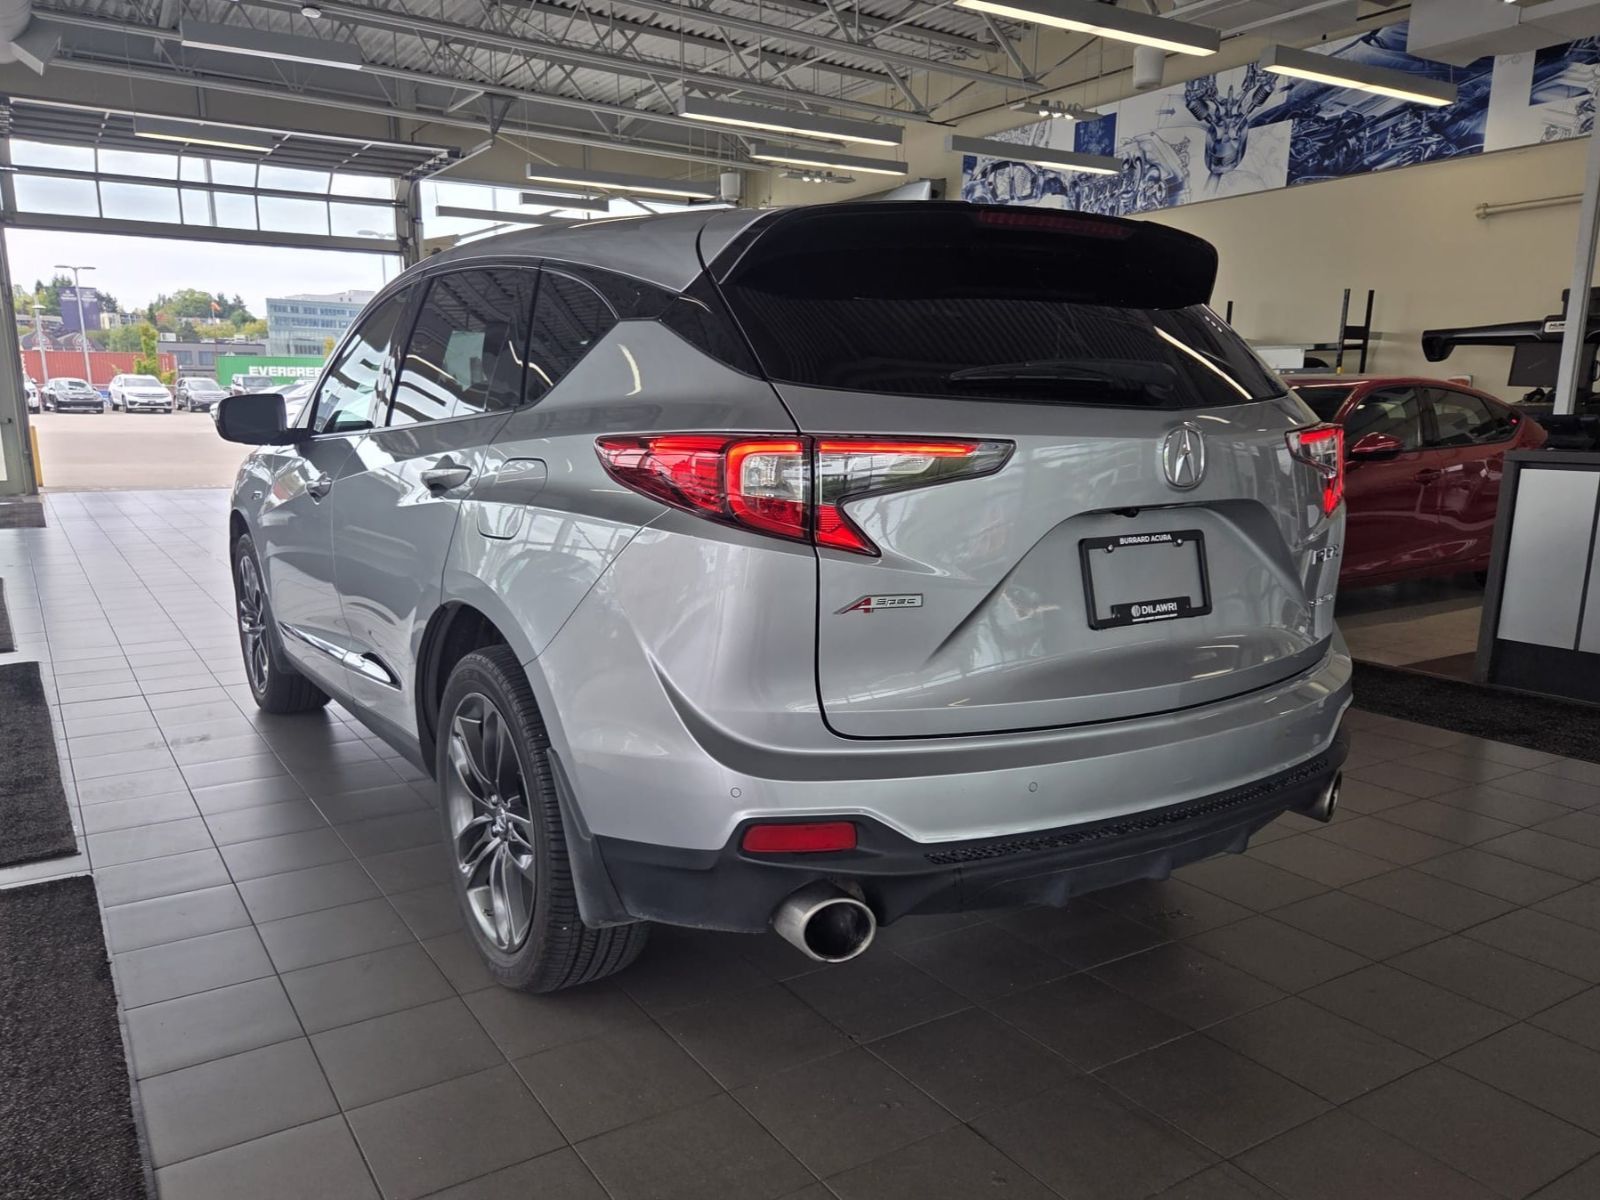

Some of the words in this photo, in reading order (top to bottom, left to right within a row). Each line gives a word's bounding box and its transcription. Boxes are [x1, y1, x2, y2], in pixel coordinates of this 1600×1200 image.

[1119, 535, 1150, 545] BURRARD
[1151, 533, 1172, 542] ACURA
[1141, 602, 1178, 615] DILAWRI
